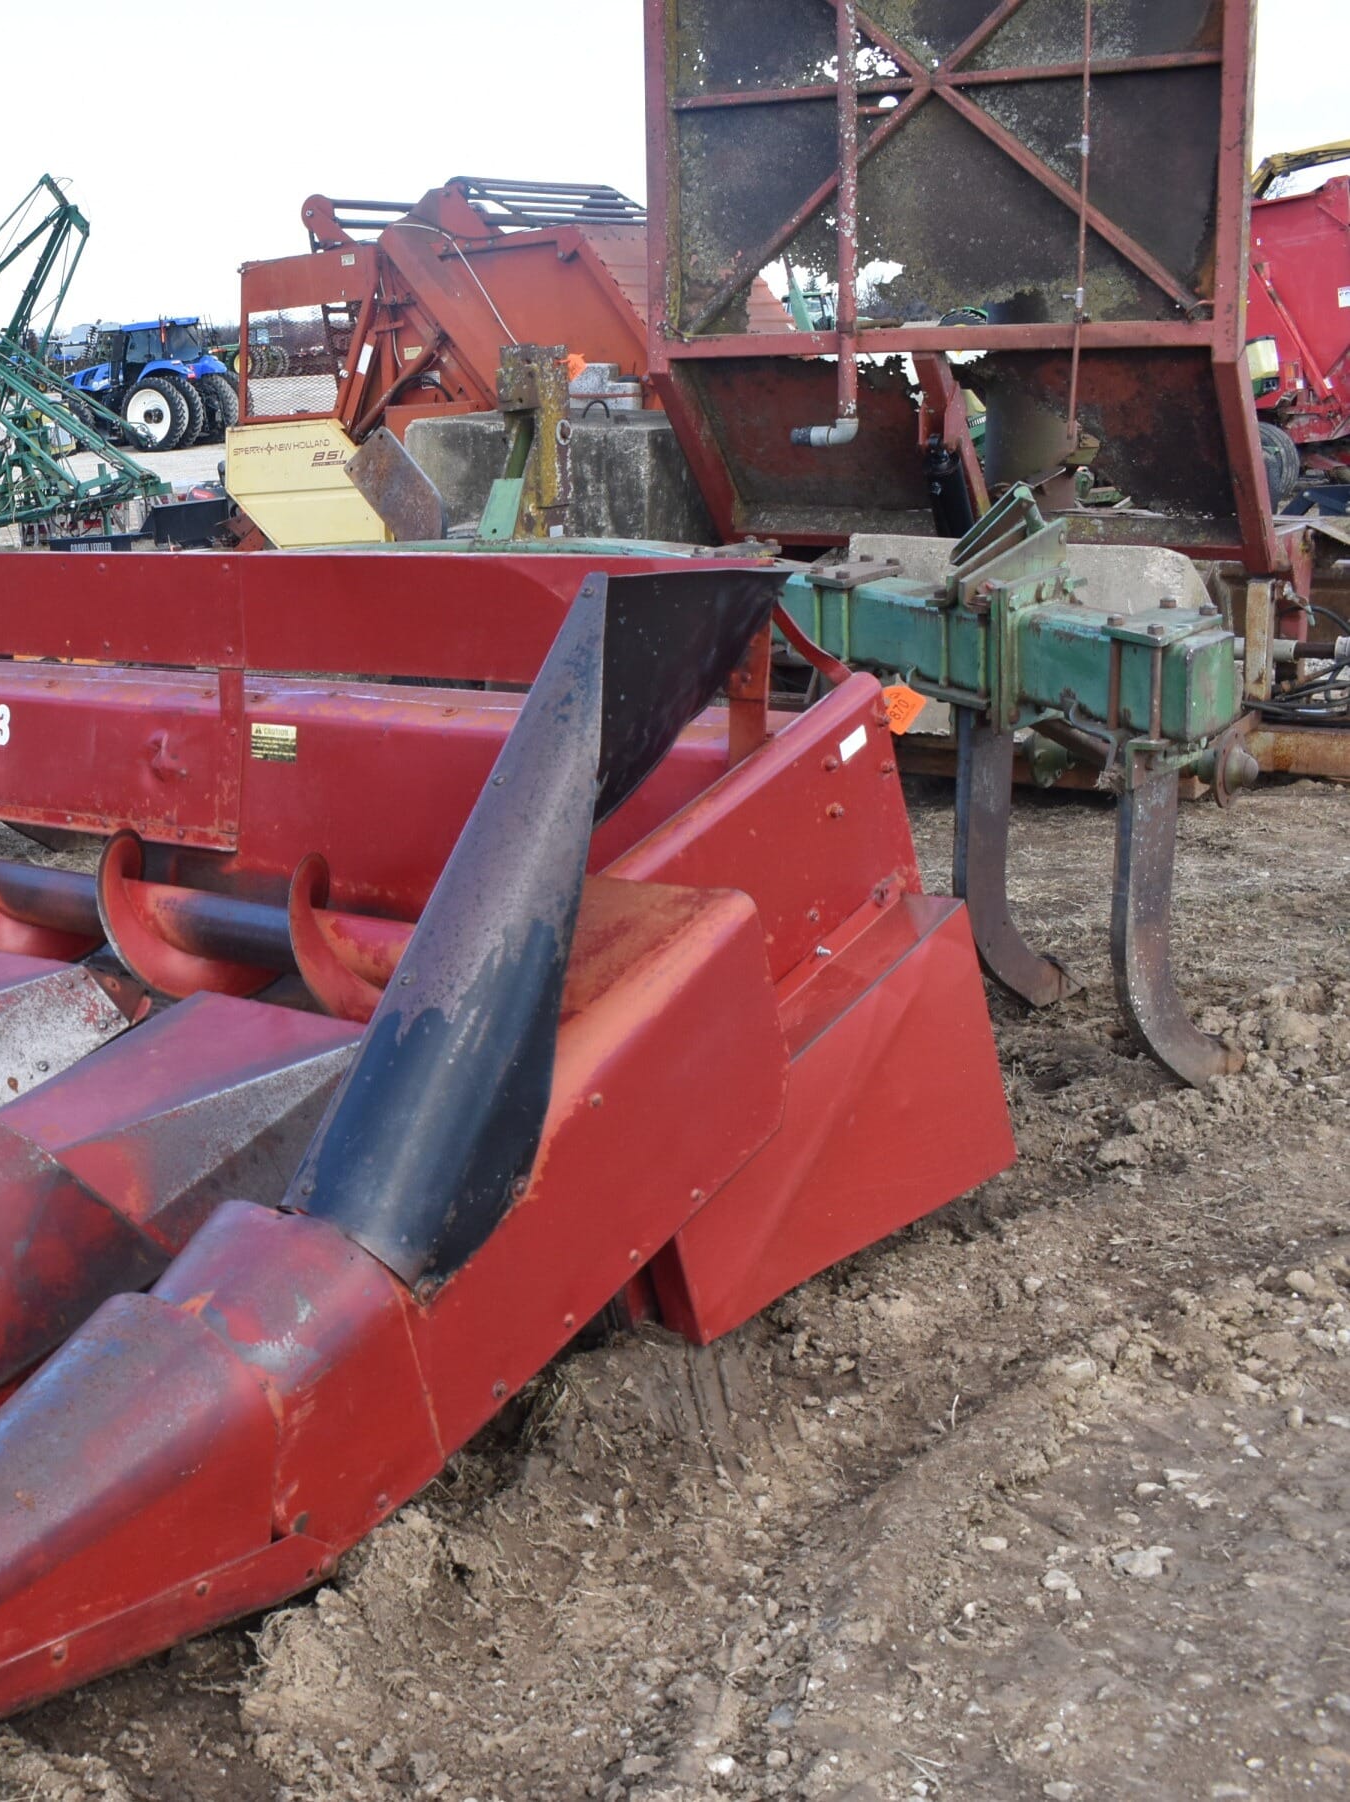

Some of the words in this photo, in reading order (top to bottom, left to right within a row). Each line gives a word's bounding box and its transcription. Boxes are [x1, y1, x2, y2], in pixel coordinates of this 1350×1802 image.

[233, 446, 265, 456] SPERRY
[274, 442, 291, 452] NEW
[293, 438, 331, 450] HOLLAND
[889, 698, 910, 720] 870
